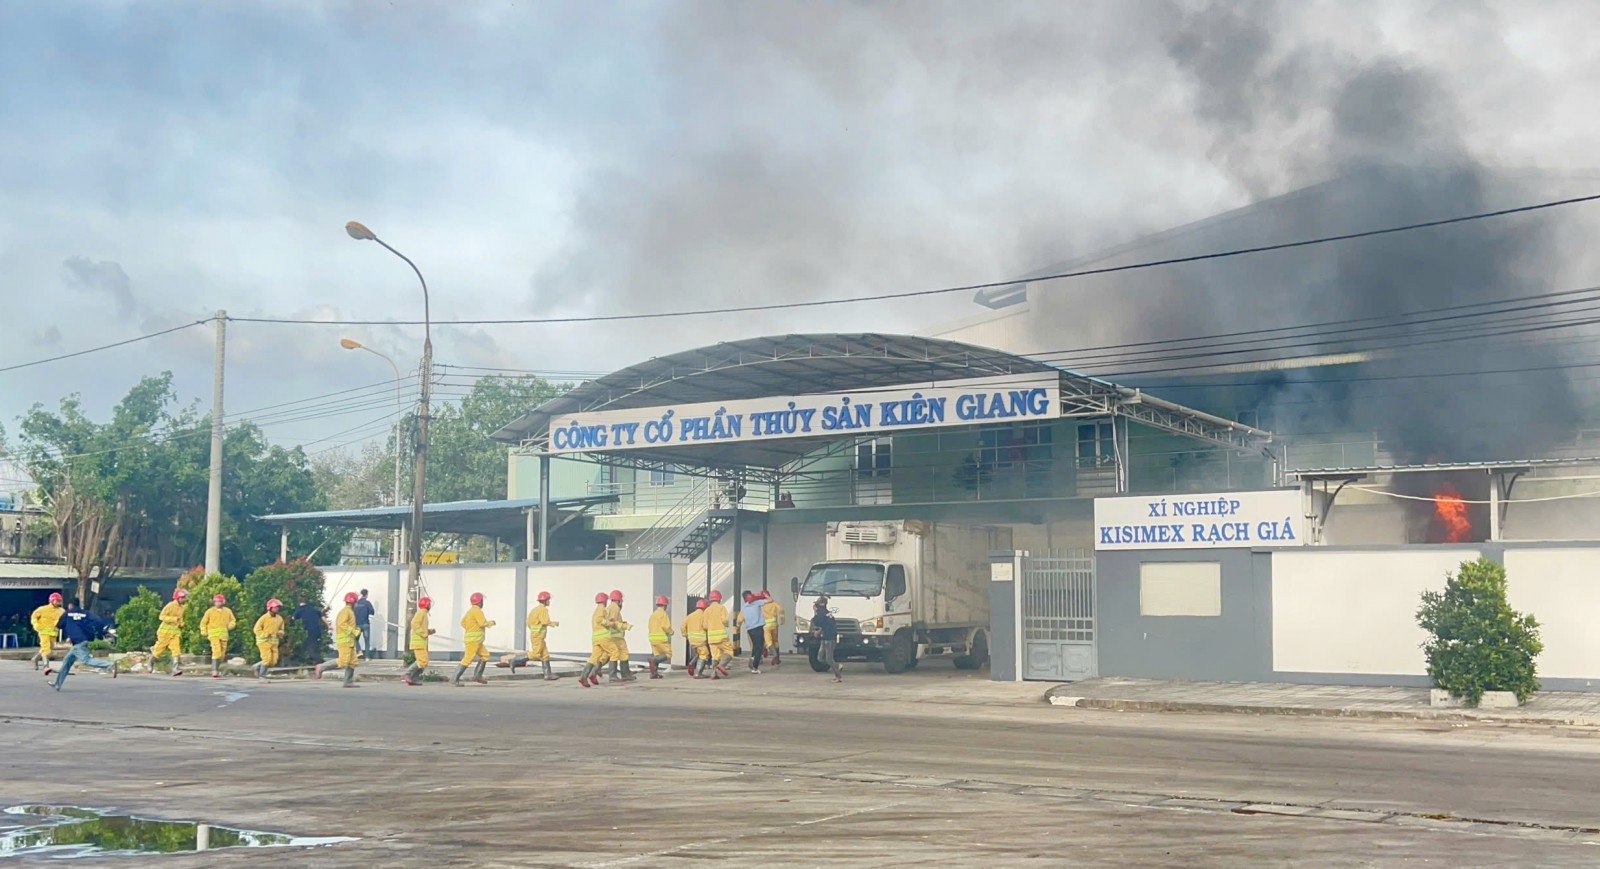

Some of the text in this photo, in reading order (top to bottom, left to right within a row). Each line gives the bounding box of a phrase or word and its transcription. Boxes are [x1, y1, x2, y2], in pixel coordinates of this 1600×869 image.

[553, 388, 1050, 449] CÔNG TY CỔ PHẦN THỦY SẢN KIÊN GIANG
[1148, 497, 1240, 517] XÍ NGHIỆP
[1100, 516, 1295, 545] KISIMEX RẠCH GIÁ
